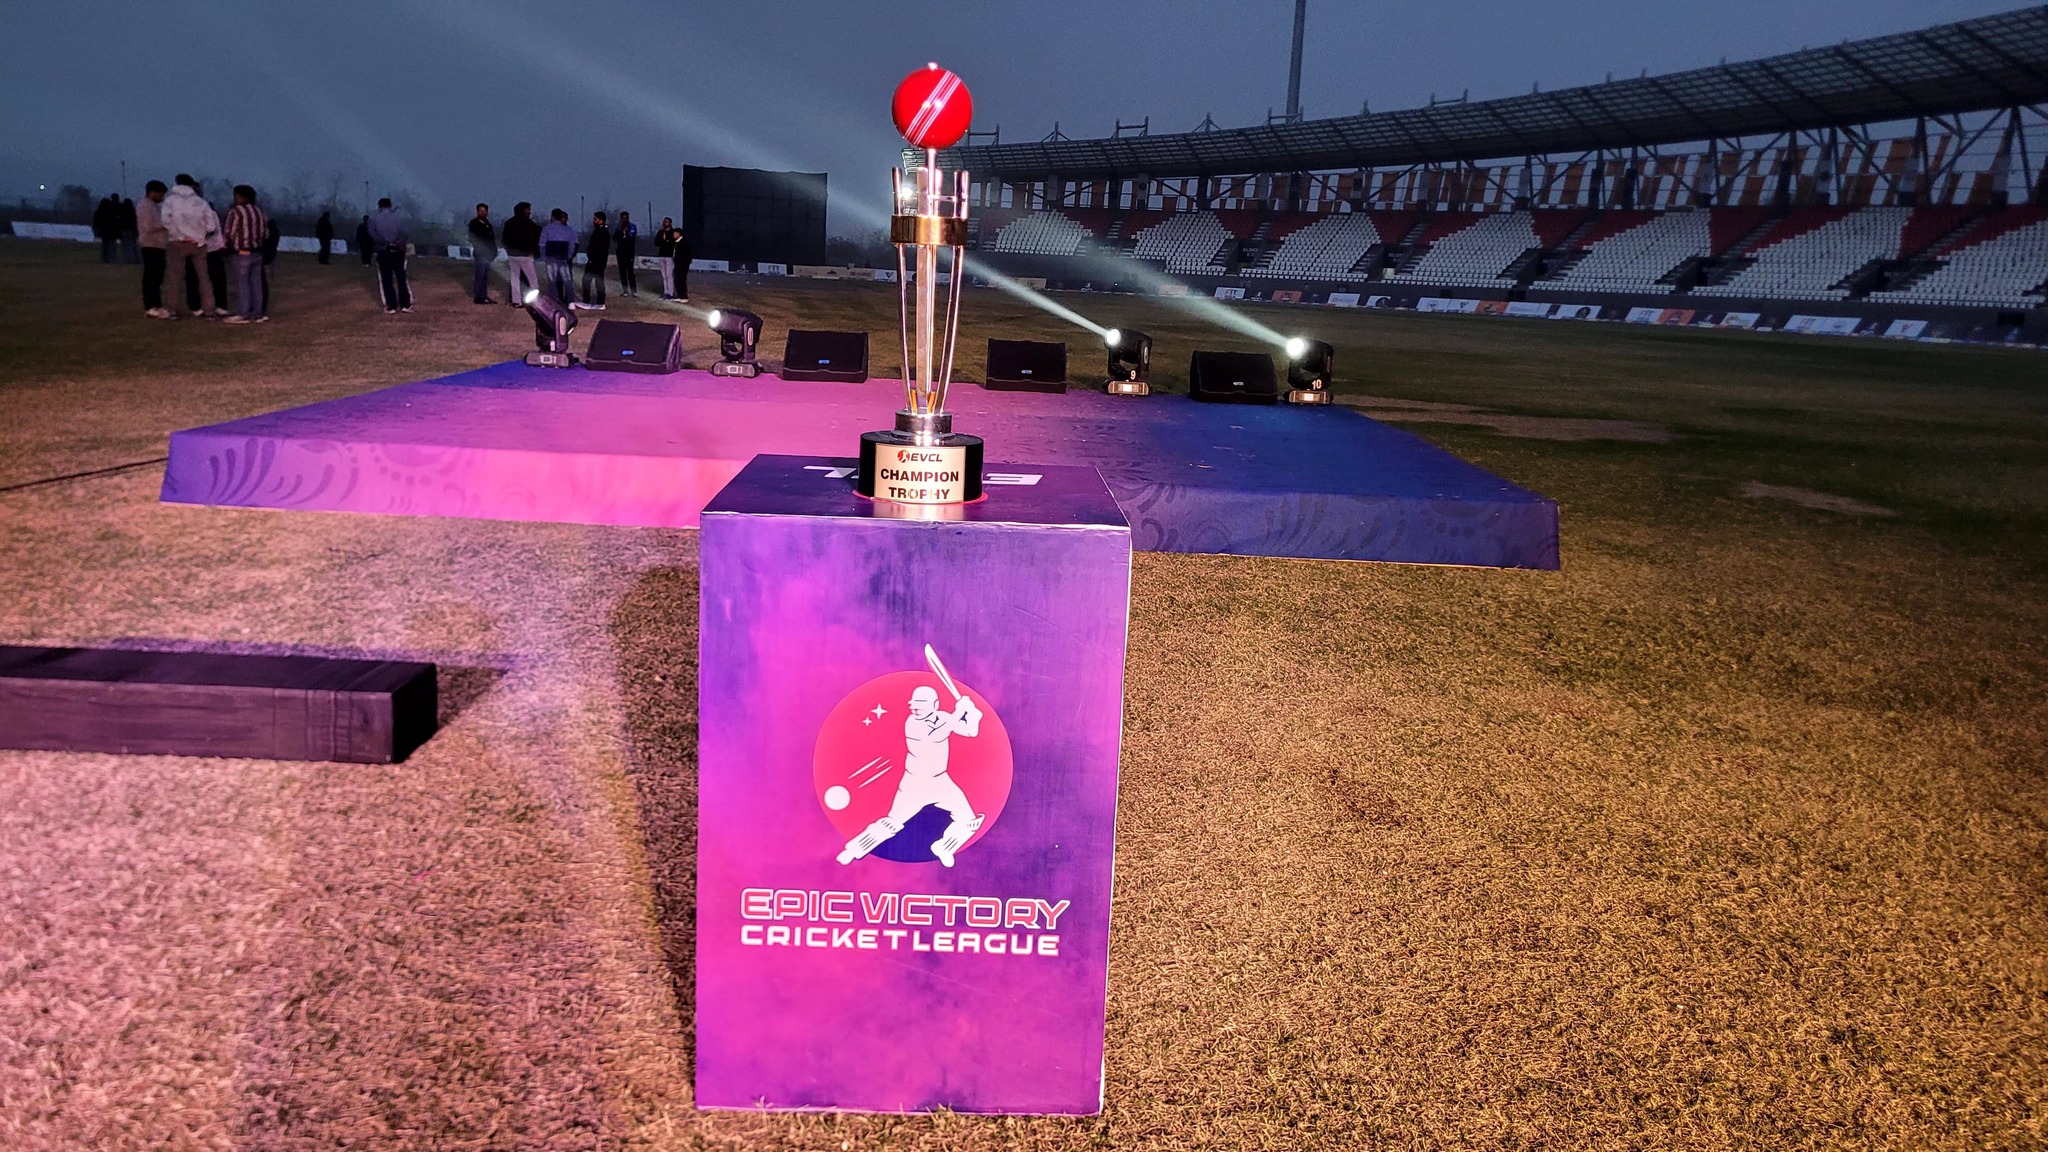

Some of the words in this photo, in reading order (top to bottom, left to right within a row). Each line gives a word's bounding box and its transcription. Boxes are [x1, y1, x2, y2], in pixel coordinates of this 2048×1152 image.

[1130, 370, 1136, 380] 9
[1311, 379, 1322, 390] 10
[911, 453, 943, 462] EVCL
[880, 468, 959, 482] CHAMPION
[888, 486, 950, 500] TROPHY
[740, 888, 855, 923] EPIC
[859, 892, 1071, 930] VICTORY
[741, 924, 908, 950] CRICKET
[912, 930, 1061, 957] LEAGUE
